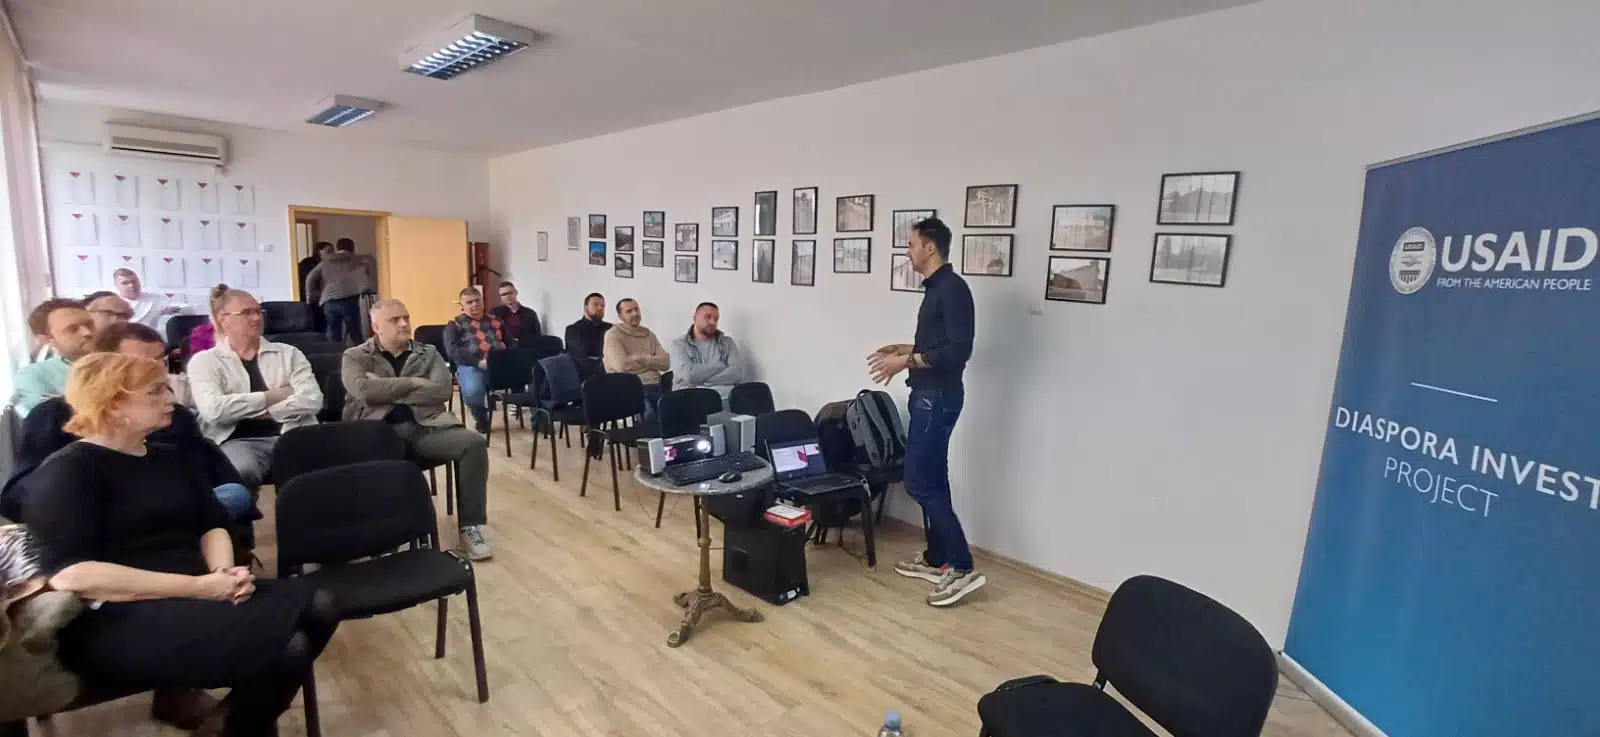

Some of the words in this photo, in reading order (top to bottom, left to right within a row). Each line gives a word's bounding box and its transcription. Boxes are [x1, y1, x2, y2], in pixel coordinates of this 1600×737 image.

[1441, 227, 1599, 272] USAID
[1436, 277, 1462, 288] FROM
[1464, 277, 1482, 288] THE
[1483, 277, 1541, 290] AMERICAN
[1543, 278, 1593, 291] PEOPLE
[1335, 406, 1459, 466] DIASPORA
[1471, 445, 1600, 510] INVEST
[1384, 456, 1500, 517] PROJECT
